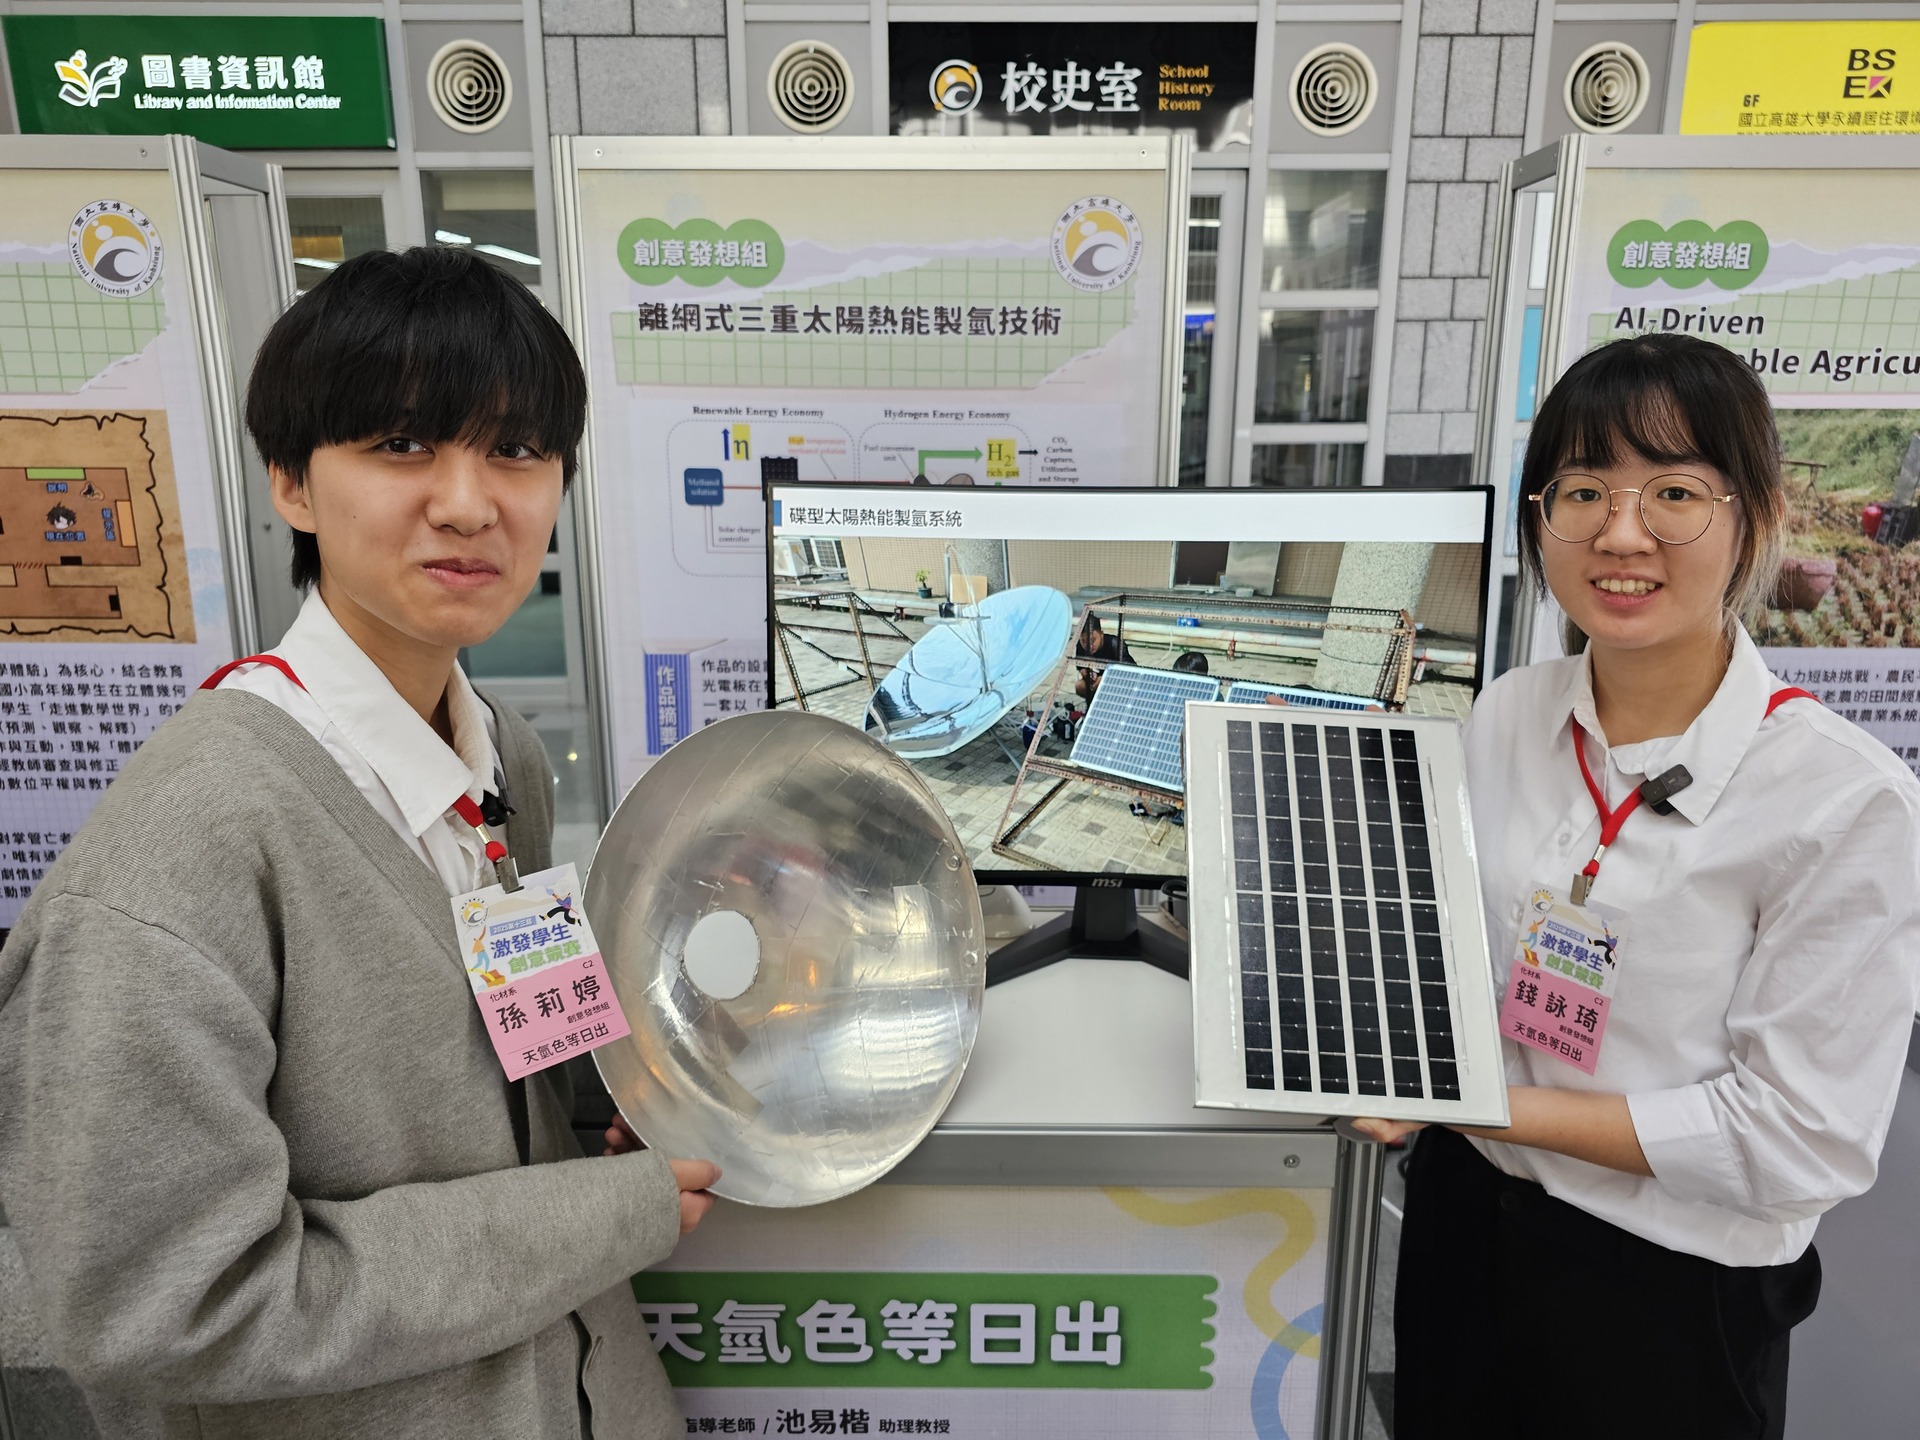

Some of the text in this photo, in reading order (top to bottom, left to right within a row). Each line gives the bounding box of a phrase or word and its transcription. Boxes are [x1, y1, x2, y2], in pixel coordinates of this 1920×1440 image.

[141, 54, 325, 89] 圖書資訊館
[1159, 64, 1209, 79] School
[1000, 61, 1143, 114] 校史室
[1159, 81, 1216, 98] History
[134, 93, 342, 111] Library and Information Center
[1159, 99, 1202, 112] Room
[632, 239, 768, 268] 創意發想組
[1621, 240, 1752, 270] 創意發想組
[638, 302, 1062, 337] 離網式三重太陽熱能製氫技術
[1615, 306, 1765, 335] AI-Driven
[693, 406, 825, 418] Renewable Energy Economy
[884, 409, 1011, 421] Hydrogen Energy Economy
[986, 468, 1020, 479] rich gas
[789, 507, 963, 527] 碟型太陽熱能製氫系統
[703, 679, 768, 693] 光電板在
[704, 698, 768, 712] 一套以「
[1092, 878, 1123, 888] msi
[490, 922, 572, 959] 激發學生
[1539, 931, 1605, 972] 激發學生
[582, 960, 594, 969] C2
[489, 987, 518, 1003] 化材系
[496, 975, 602, 1034] 孫莉婷
[1514, 979, 1600, 1033] 錢詠琦
[1593, 996, 1604, 1006] C2
[567, 1002, 611, 1024] 創意發想組
[522, 1022, 610, 1065] 天氫色等日出
[1513, 1021, 1583, 1062] 天氫色等日出
[1558, 1024, 1595, 1047] 創意發想組
[641, 1300, 1122, 1366] 天氫色等日出
[776, 1408, 870, 1435] 池易楷
[878, 1418, 951, 1434] 助理教授
